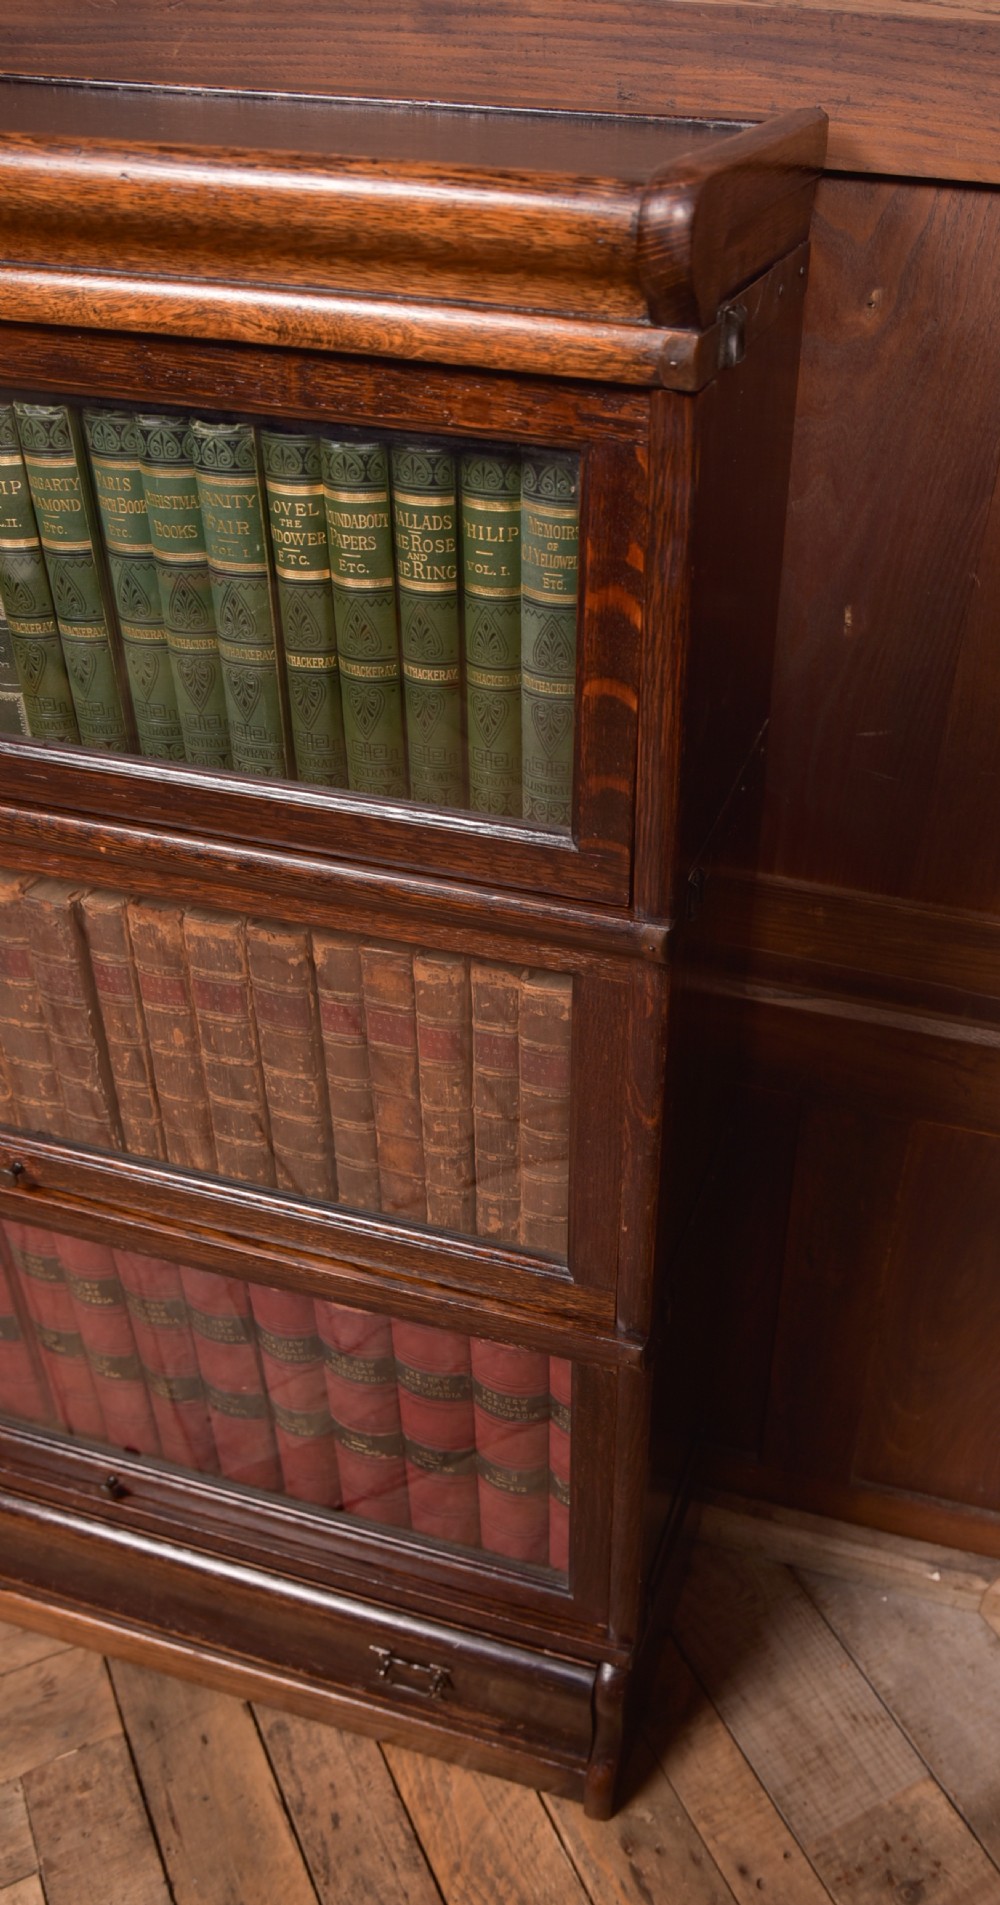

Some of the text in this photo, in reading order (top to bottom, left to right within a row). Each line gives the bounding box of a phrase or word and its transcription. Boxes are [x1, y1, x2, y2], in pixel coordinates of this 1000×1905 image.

[154, 519, 198, 538] BOOKS
[279, 518, 303, 528] THE
[330, 527, 377, 550] PAPERS
[410, 534, 456, 553] ROSE
[547, 542, 559, 552] OF
[278, 550, 310, 565] ETC.
[407, 552, 428, 562] AND
[339, 558, 370, 574] ETC.
[412, 560, 457, 580] RING
[467, 560, 496, 576] VOL.
[543, 577, 567, 591] ETC.
